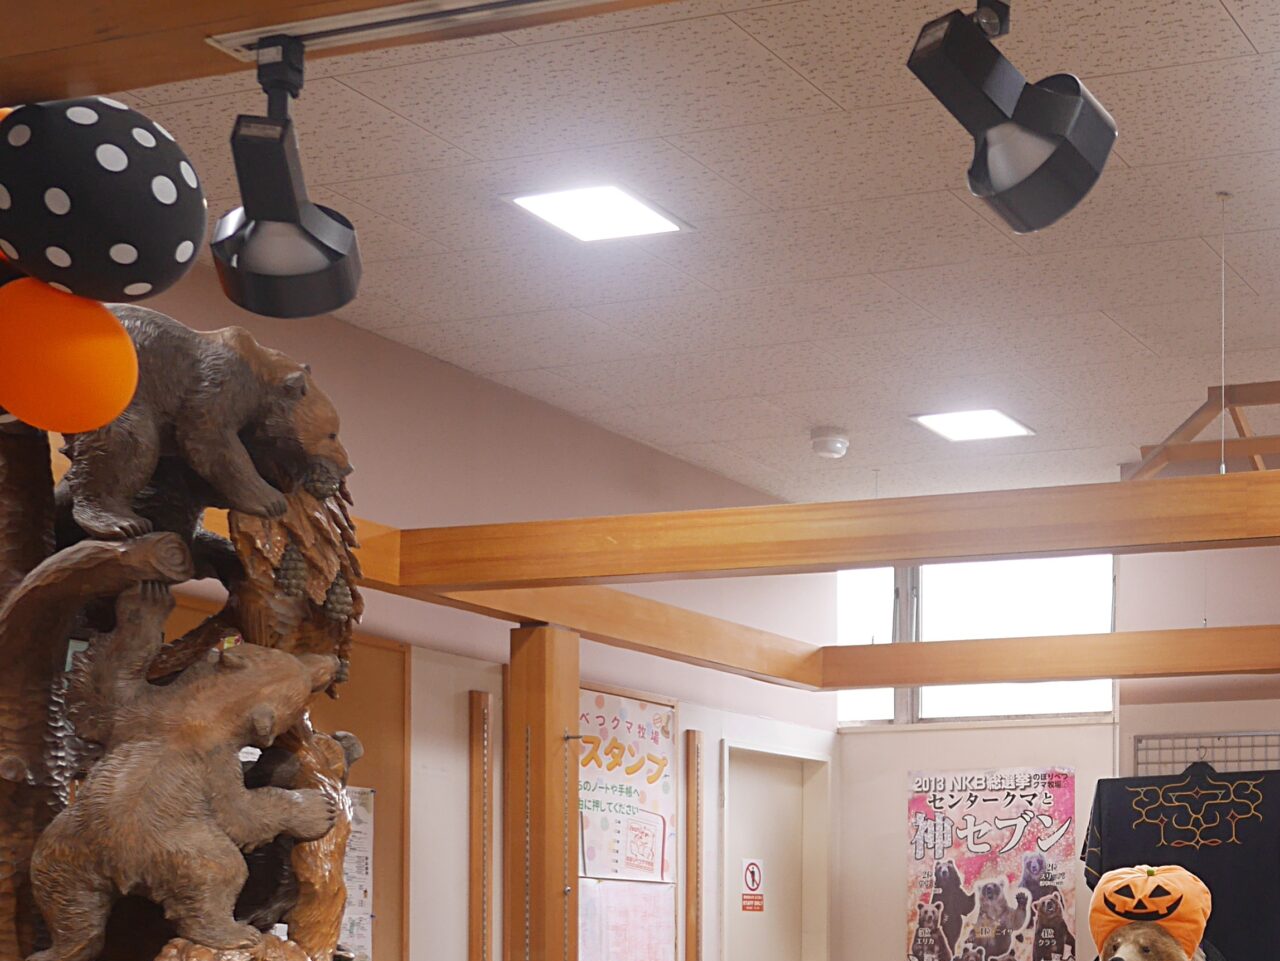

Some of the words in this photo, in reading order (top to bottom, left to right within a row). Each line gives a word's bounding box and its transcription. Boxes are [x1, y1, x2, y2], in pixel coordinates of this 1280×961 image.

[581, 735, 668, 785] スタンプ
[914, 777, 945, 793] 2013
[911, 810, 1073, 860] 神セブン
